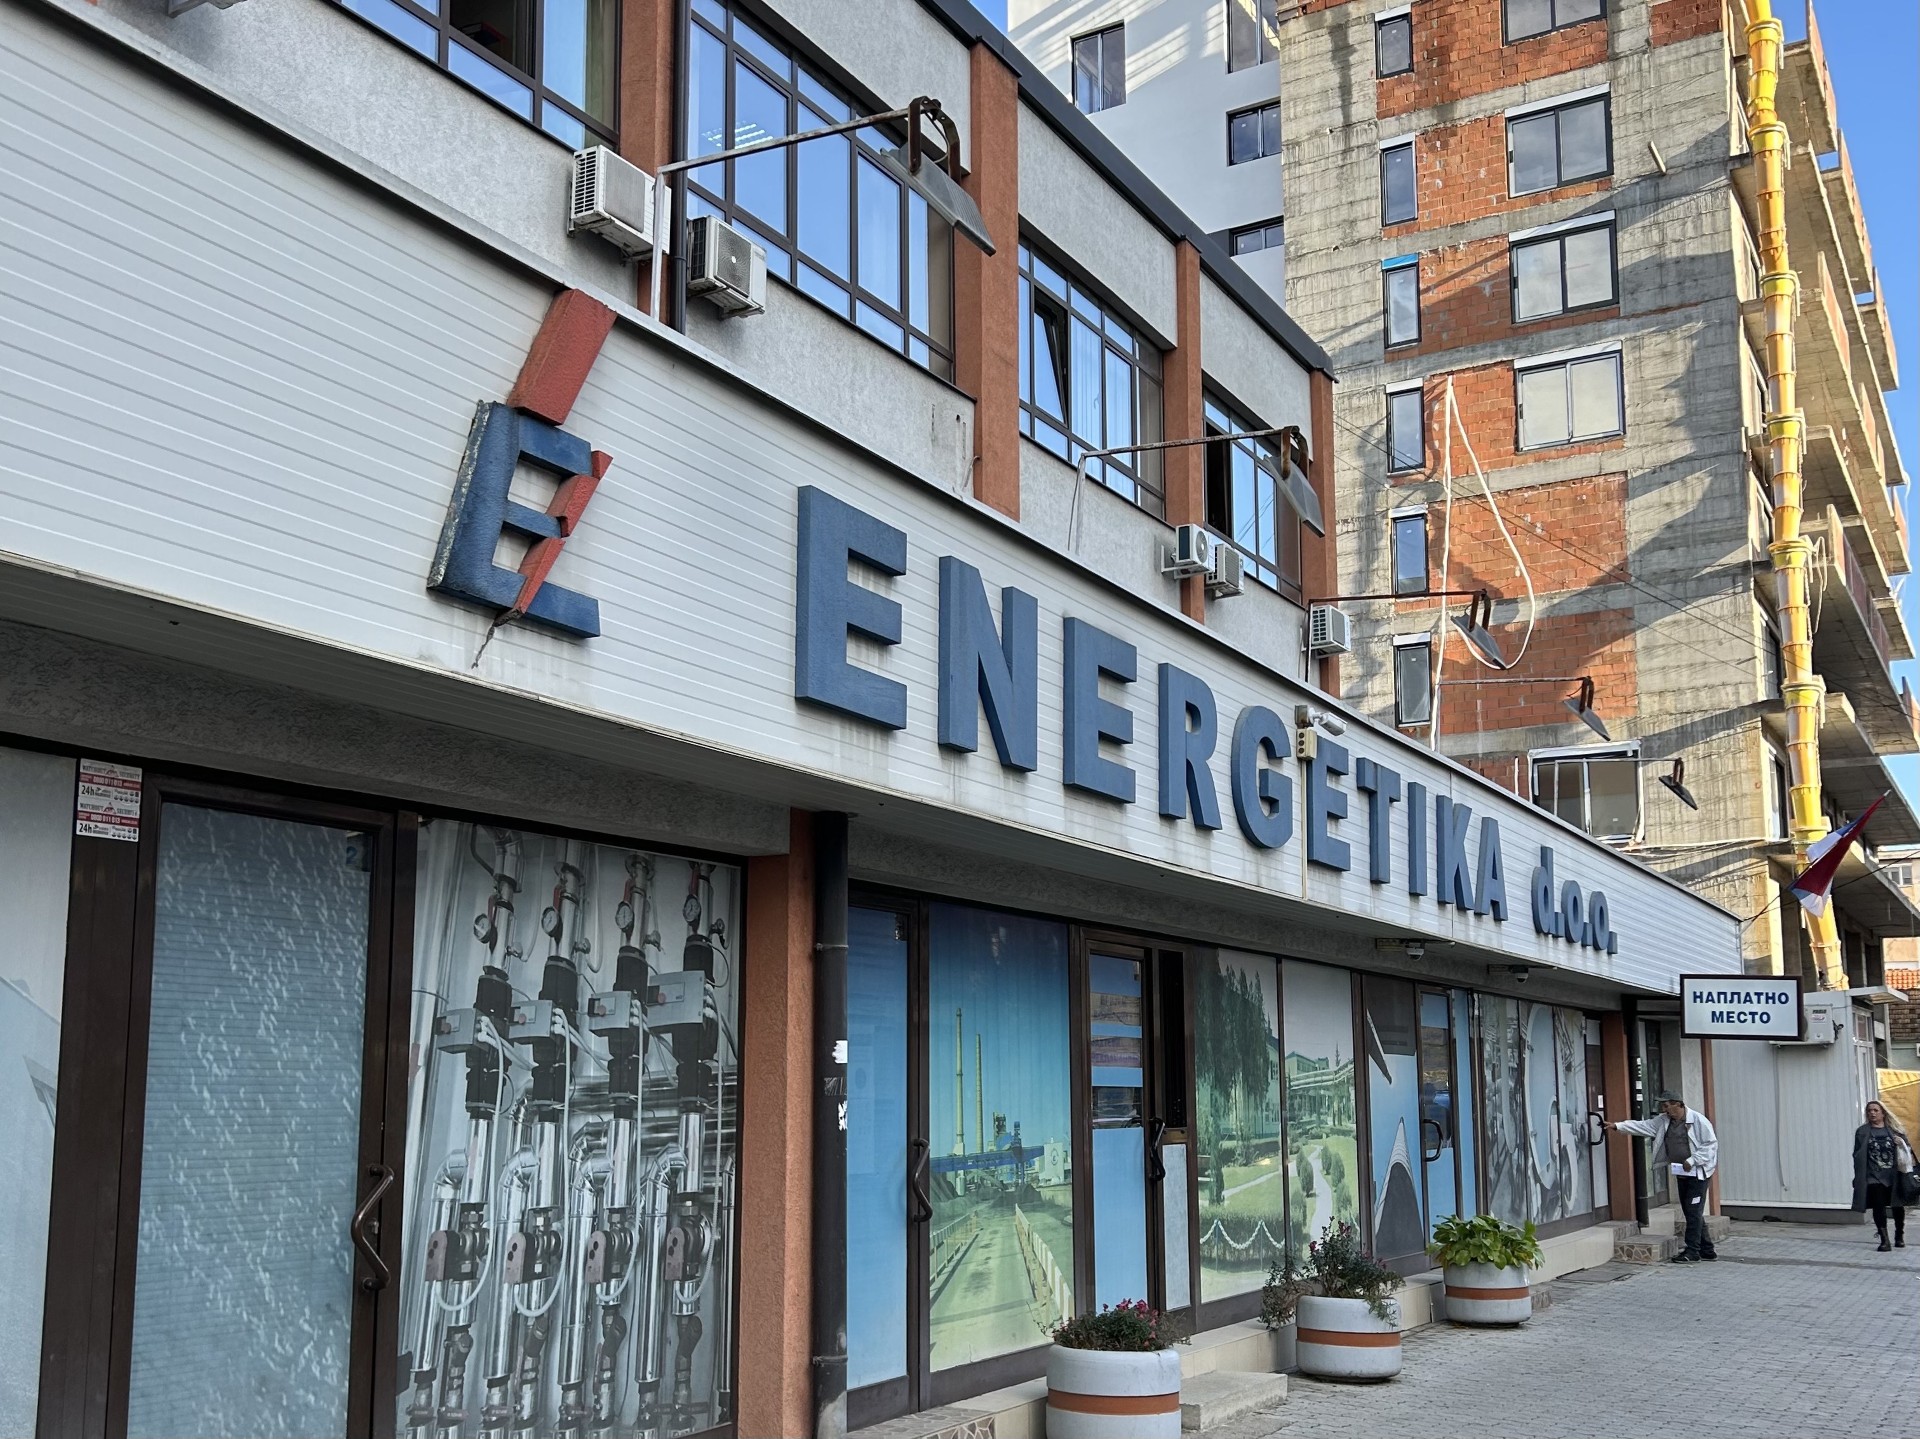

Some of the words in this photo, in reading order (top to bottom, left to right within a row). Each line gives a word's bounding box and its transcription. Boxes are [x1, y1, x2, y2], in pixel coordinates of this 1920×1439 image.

[795, 485, 1508, 921] ENERGETIKA
[1531, 846, 1618, 954] d.o.o.
[81, 785, 95, 796] 24h
[79, 823, 92, 834] 24h
[1692, 991, 1790, 1005] НАПЛАТНО
[1711, 1010, 1771, 1024] МЕСТО
